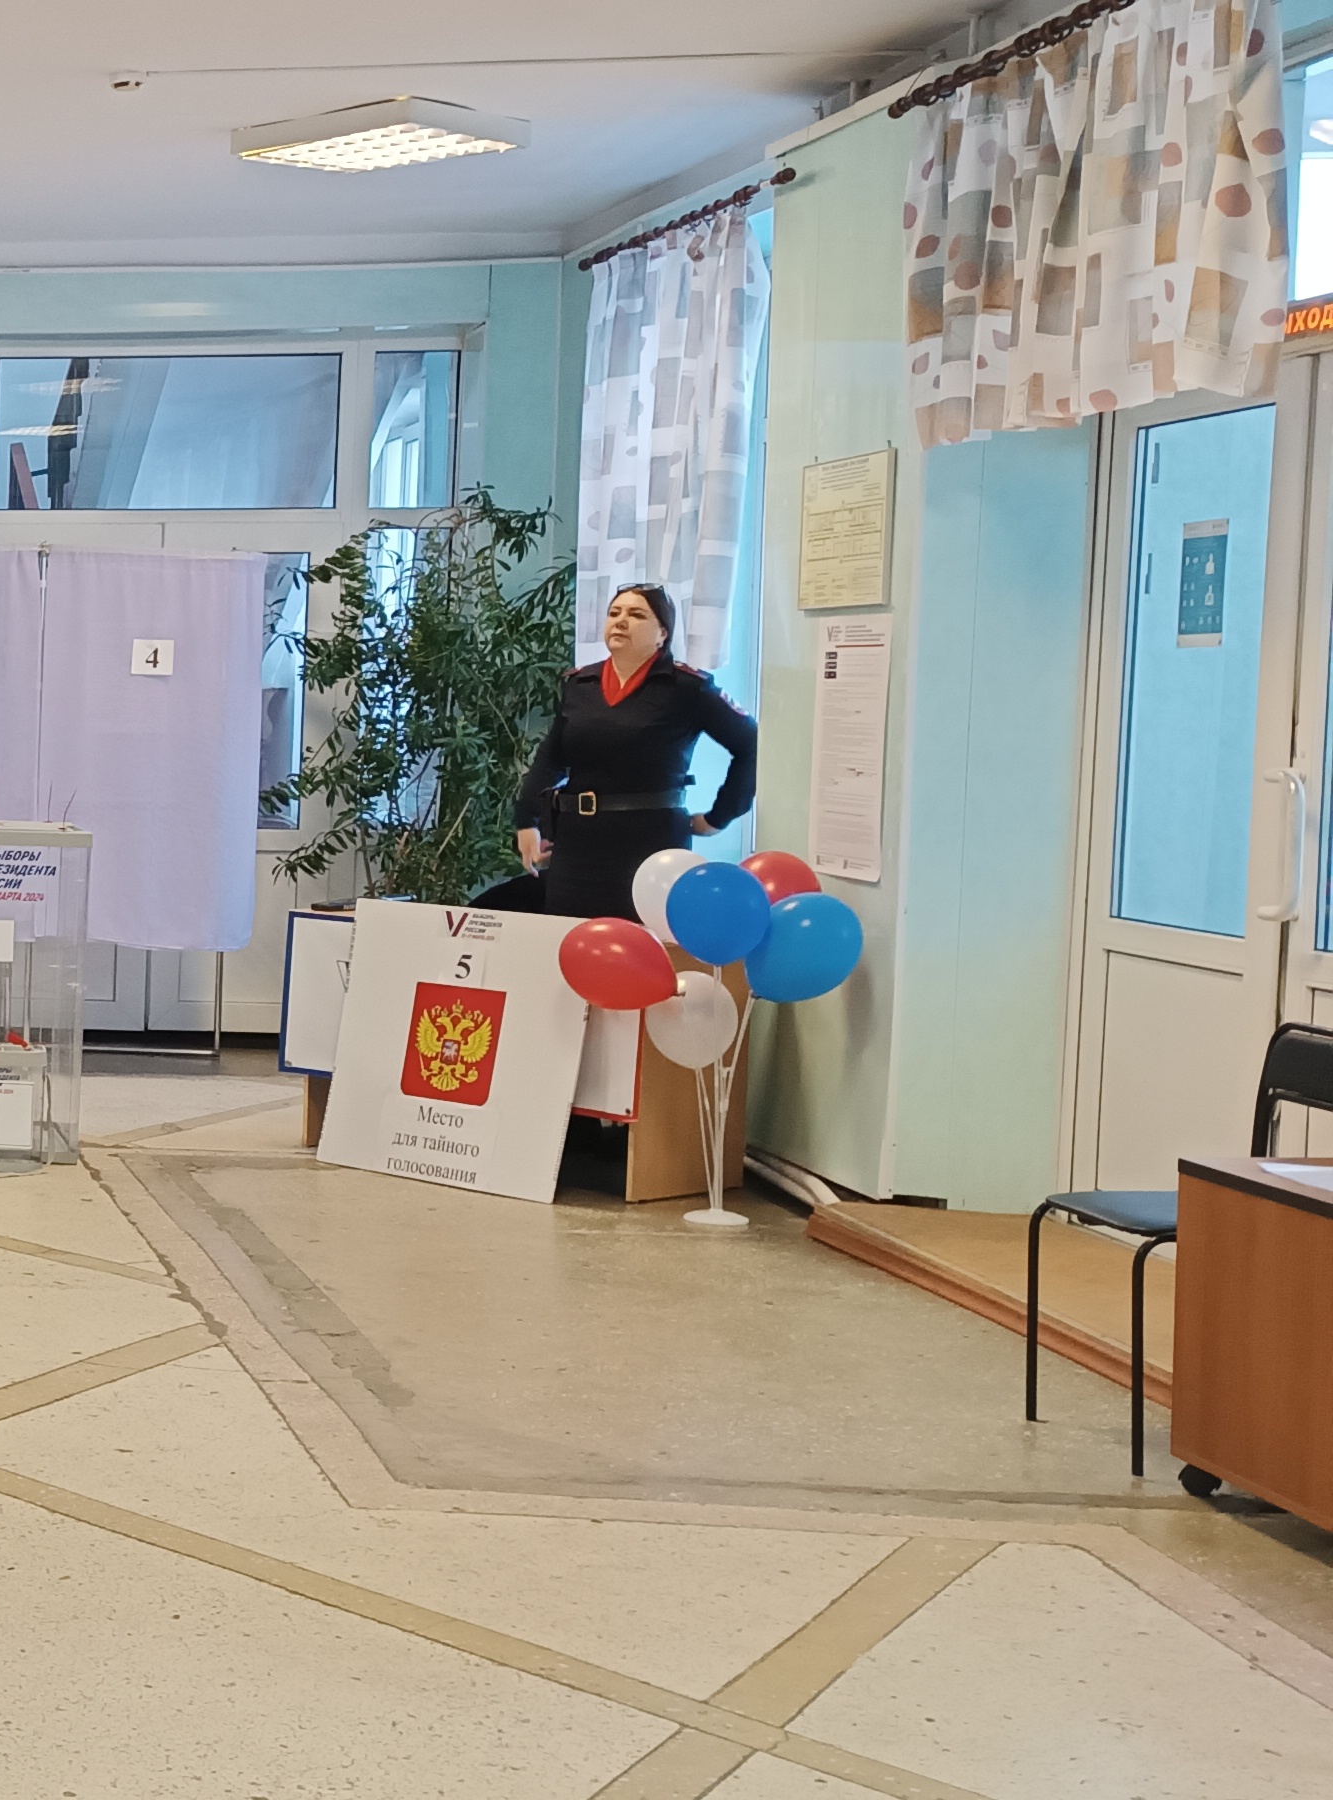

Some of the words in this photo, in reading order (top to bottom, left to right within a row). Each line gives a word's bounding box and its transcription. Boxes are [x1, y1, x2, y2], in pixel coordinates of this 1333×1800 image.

[145, 647, 160, 668] 4
[23, 892, 45, 902] 2024
[454, 954, 473, 979] 5
[417, 1105, 464, 1128] Место
[392, 1132, 418, 1147] для
[423, 1135, 480, 1158] тайного
[387, 1157, 477, 1185] голосования
